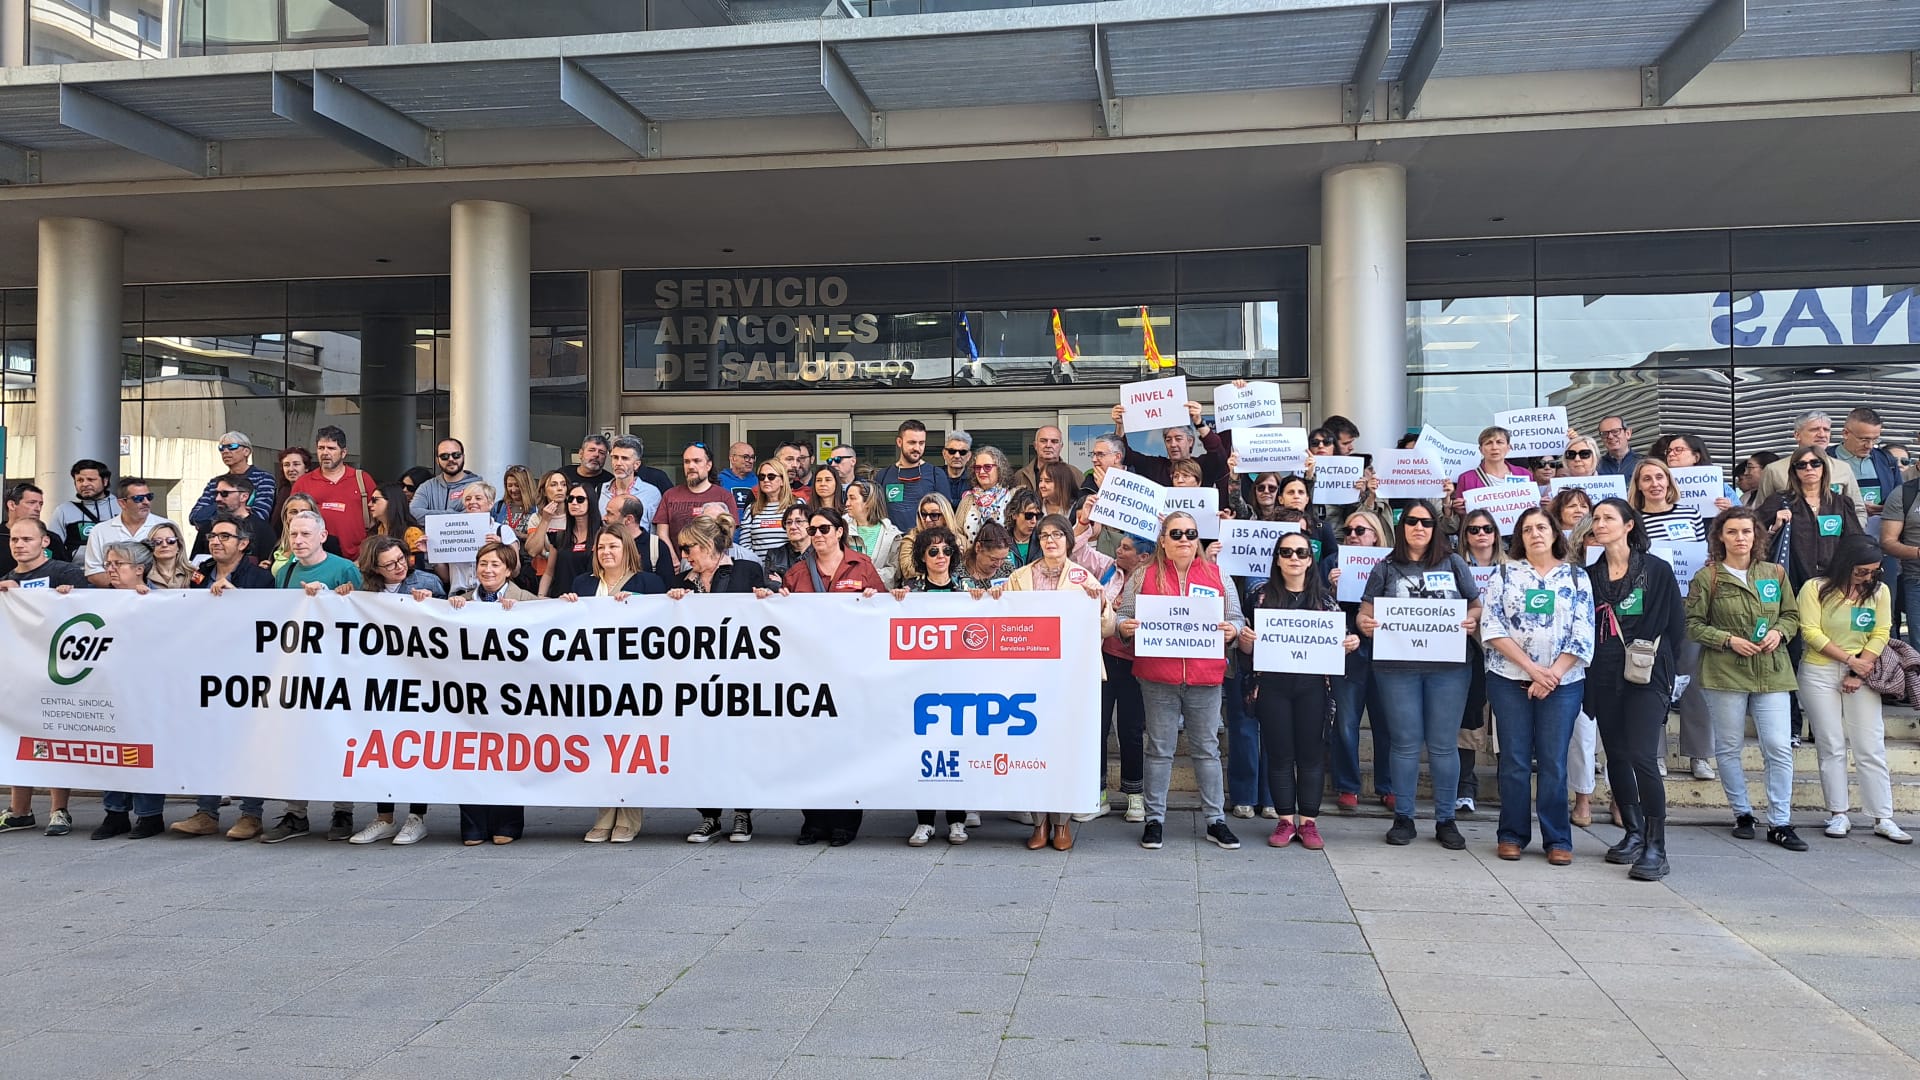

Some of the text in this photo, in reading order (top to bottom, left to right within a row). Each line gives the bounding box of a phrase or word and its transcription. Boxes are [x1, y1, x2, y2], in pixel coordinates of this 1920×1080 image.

[654, 276, 848, 309] SERVICIO
[653, 313, 879, 345] ARAGONES
[656, 352, 708, 382] DE
[721, 351, 856, 382] SALUD
[1130, 388, 1174, 404] ¡NIVEL 4
[1237, 389, 1253, 399] ¡SIN
[1217, 399, 1277, 412] NOSOTR@S NO
[1144, 407, 1162, 419] YA!
[1219, 410, 1275, 424] HAY SANIDAD!
[1508, 412, 1556, 425] ¡CARRERA
[1508, 427, 1565, 437] ROFESIONAL
[1425, 433, 1477, 457] ¡PROMOCIÓN
[1508, 440, 1565, 452] ARA TODOS!
[1241, 455, 1301, 463] TAMBIÉN CUENTAN!
[1412, 457, 1429, 465] MÁS
[1314, 465, 1359, 475] PACTADO
[1391, 468, 1433, 476] PROMESAS,
[1110, 475, 1155, 499] ¡CARRERA
[1376, 478, 1416, 486] QUEREMOS
[1583, 481, 1615, 490] SOBRAN
[1473, 488, 1531, 504] ¡CATEGORÍAS
[1100, 489, 1158, 517] PROFESIONAL
[1198, 499, 1205, 509] 4
[1093, 503, 1157, 533] PARA TOD@S!
[1499, 516, 1514, 525] YA!
[1232, 528, 1250, 539] ¡35
[434, 546, 457, 554] TAMBIÉN
[1231, 543, 1257, 556] 1DÍA
[1248, 562, 1266, 574] YA!
[1169, 607, 1190, 617] ¡SIN
[1386, 605, 1456, 617] ¡CATEGORÍAS
[1000, 624, 1034, 633] Sanidad
[1140, 621, 1218, 633] NOSOTR@S NO
[1265, 617, 1334, 629] ¡CATEGORÍAS
[1380, 622, 1460, 633] ACTUALIZADAS
[255, 616, 781, 662] POR TODAS LAS CATEGORÍAS
[896, 625, 958, 650] UGT
[1000, 634, 1028, 644] Aragón
[1143, 637, 1216, 648] HAY SANIDAD!
[1260, 633, 1338, 645] ACTUALIZADAS
[1411, 638, 1428, 648] YA!
[1290, 650, 1308, 660] YA!
[200, 673, 838, 718] POR UNA MEJOR SANIDAD PÚBLICA
[40, 698, 115, 708] CENTRAL SINDICAL
[42, 710, 116, 721] INDEPENDIENTE Y
[913, 692, 1038, 736] FTPS
[43, 722, 117, 734] DE FUNCIONARIOS
[52, 743, 119, 765] CCOO
[342, 729, 670, 778] ¡ACUERDOS YA!
[968, 757, 1047, 770] TCAE ARAGÓN
